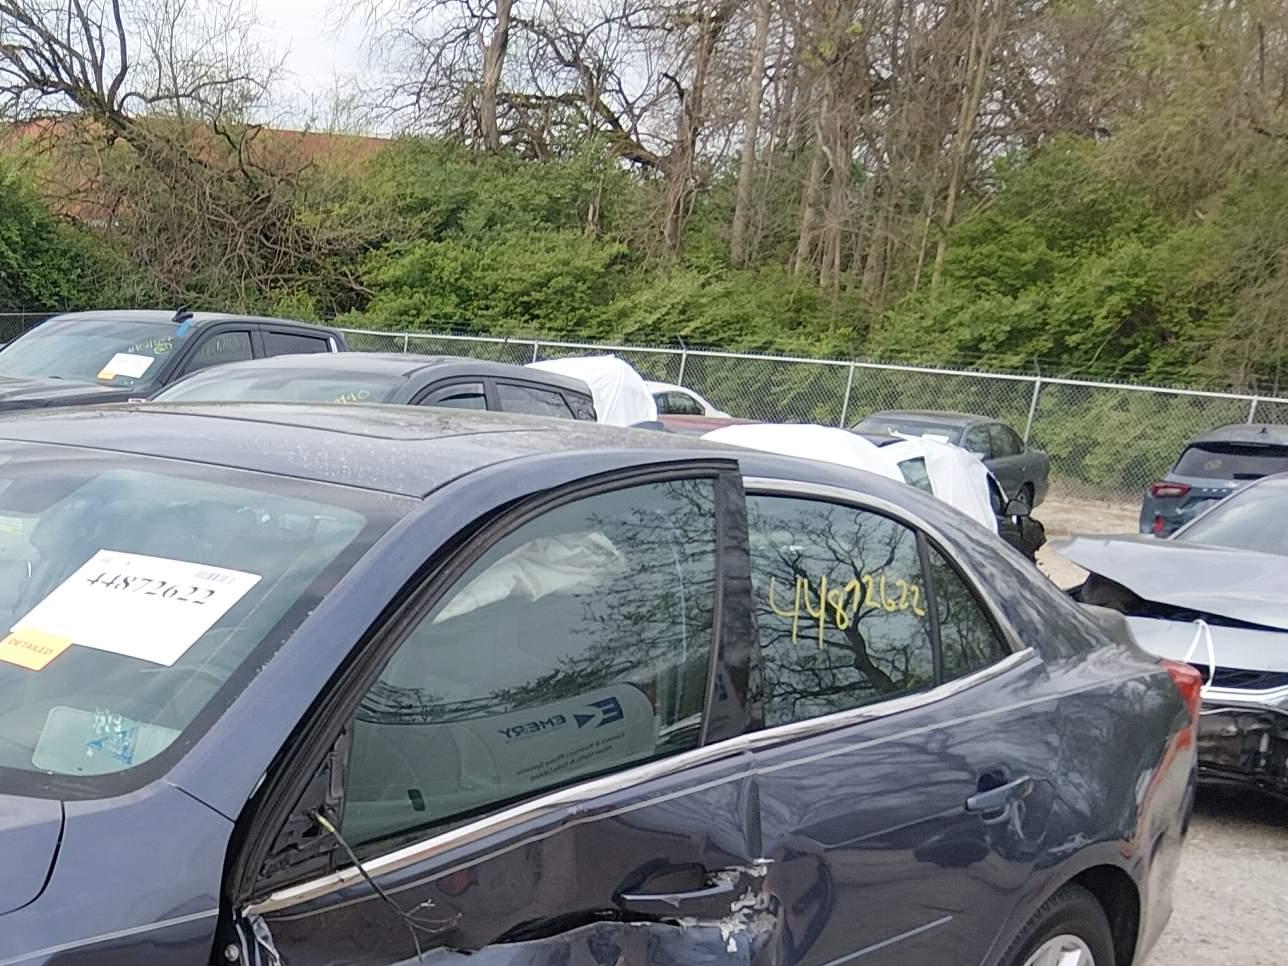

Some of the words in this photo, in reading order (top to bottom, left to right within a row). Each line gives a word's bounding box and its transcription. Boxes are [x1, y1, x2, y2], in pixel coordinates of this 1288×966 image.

[87, 572, 215, 605] 44872622
[769, 574, 926, 651] 44872622
[7, 637, 54, 656] DETAILED
